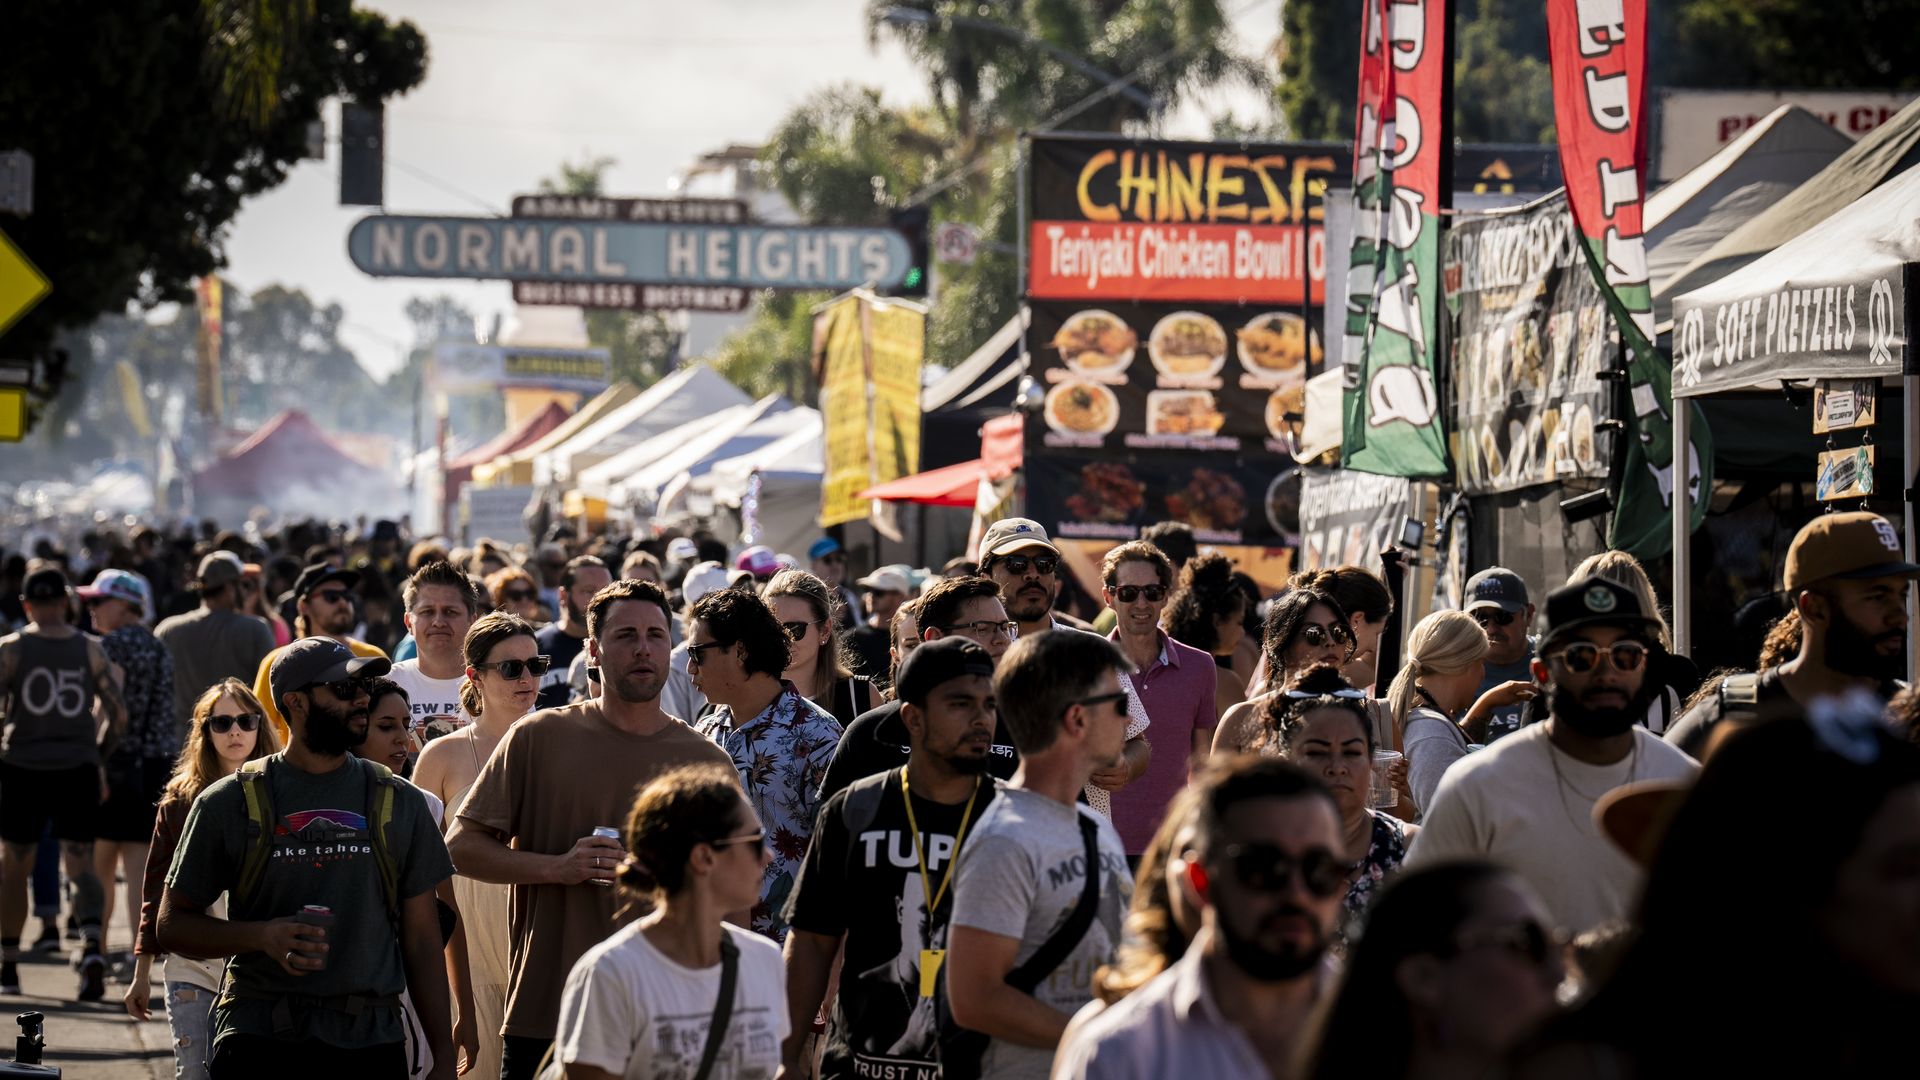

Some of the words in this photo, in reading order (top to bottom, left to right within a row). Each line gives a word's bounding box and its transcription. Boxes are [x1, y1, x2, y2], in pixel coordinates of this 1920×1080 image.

[1077, 149, 1336, 224] CHINESE
[520, 197, 617, 217] ADAMS
[630, 201, 739, 221] AVENUE
[371, 223, 627, 276] NORMAL
[668, 228, 892, 281] HEIGHTS
[1047, 227, 1133, 290] Teriyaki
[1139, 227, 1229, 277] Chicken
[1235, 230, 1292, 280] Bowl
[518, 283, 634, 306] BUSINESS
[643, 287, 744, 309] DISTRICT
[1713, 300, 1762, 366] SOFT
[1765, 283, 1856, 355] PRETZELS
[21, 666, 87, 718] 05
[410, 703, 439, 715] EW
[272, 847, 307, 858] ake
[315, 843, 371, 855] tahoe
[853, 1057, 910, 1080] TRUST
